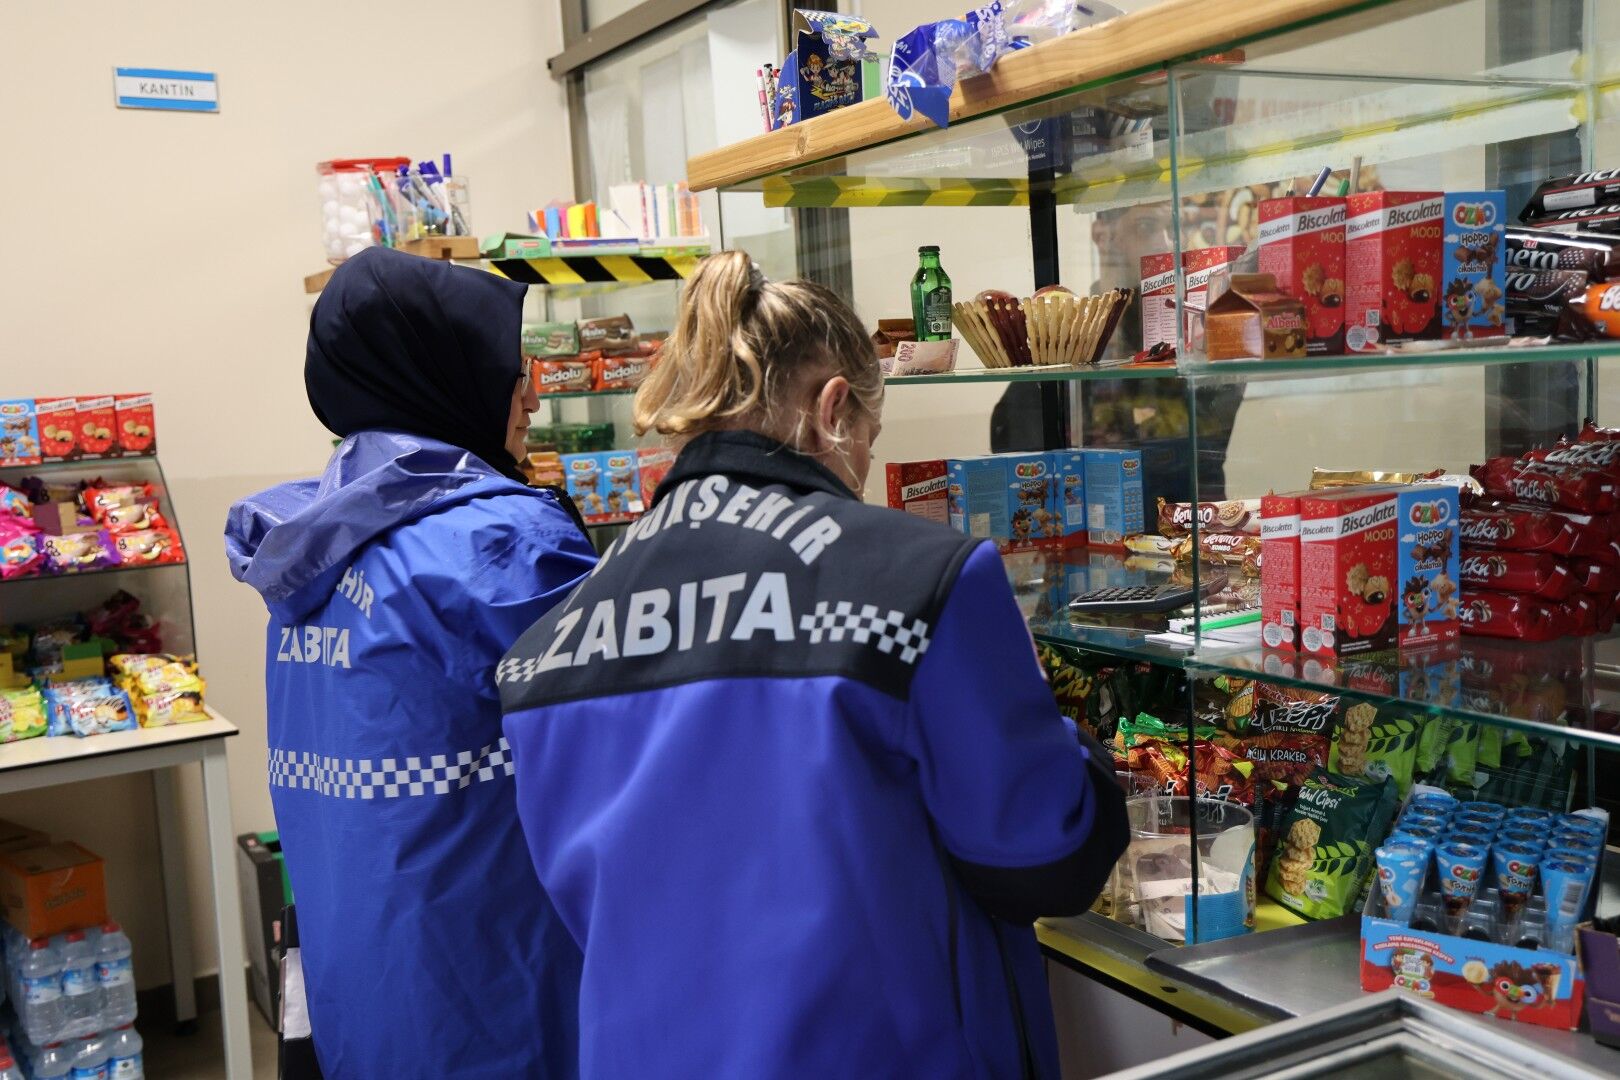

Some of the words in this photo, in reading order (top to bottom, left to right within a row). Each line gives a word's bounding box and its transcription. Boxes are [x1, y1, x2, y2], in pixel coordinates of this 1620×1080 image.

[1297, 208, 1346, 233] Biscolat
[1387, 202, 1443, 227] Biscolata
[1260, 223, 1291, 239] Biscolata
[1347, 217, 1380, 235] Biscolata
[1410, 226, 1441, 239] MOOD
[1321, 232, 1345, 243] MOO
[541, 369, 582, 385] bidolu
[603, 364, 641, 381] bidolu
[906, 480, 947, 499] Biscolata
[1513, 478, 1547, 502] Tutku
[1341, 504, 1397, 535] Biscolata
[1262, 523, 1293, 535] Biscolata
[1302, 526, 1334, 538] Biscolata
[1364, 528, 1395, 544] MOOD
[534, 571, 795, 674] ZABITA
[276, 623, 352, 670] ZABITA
[1270, 749, 1307, 763] KRAKER
